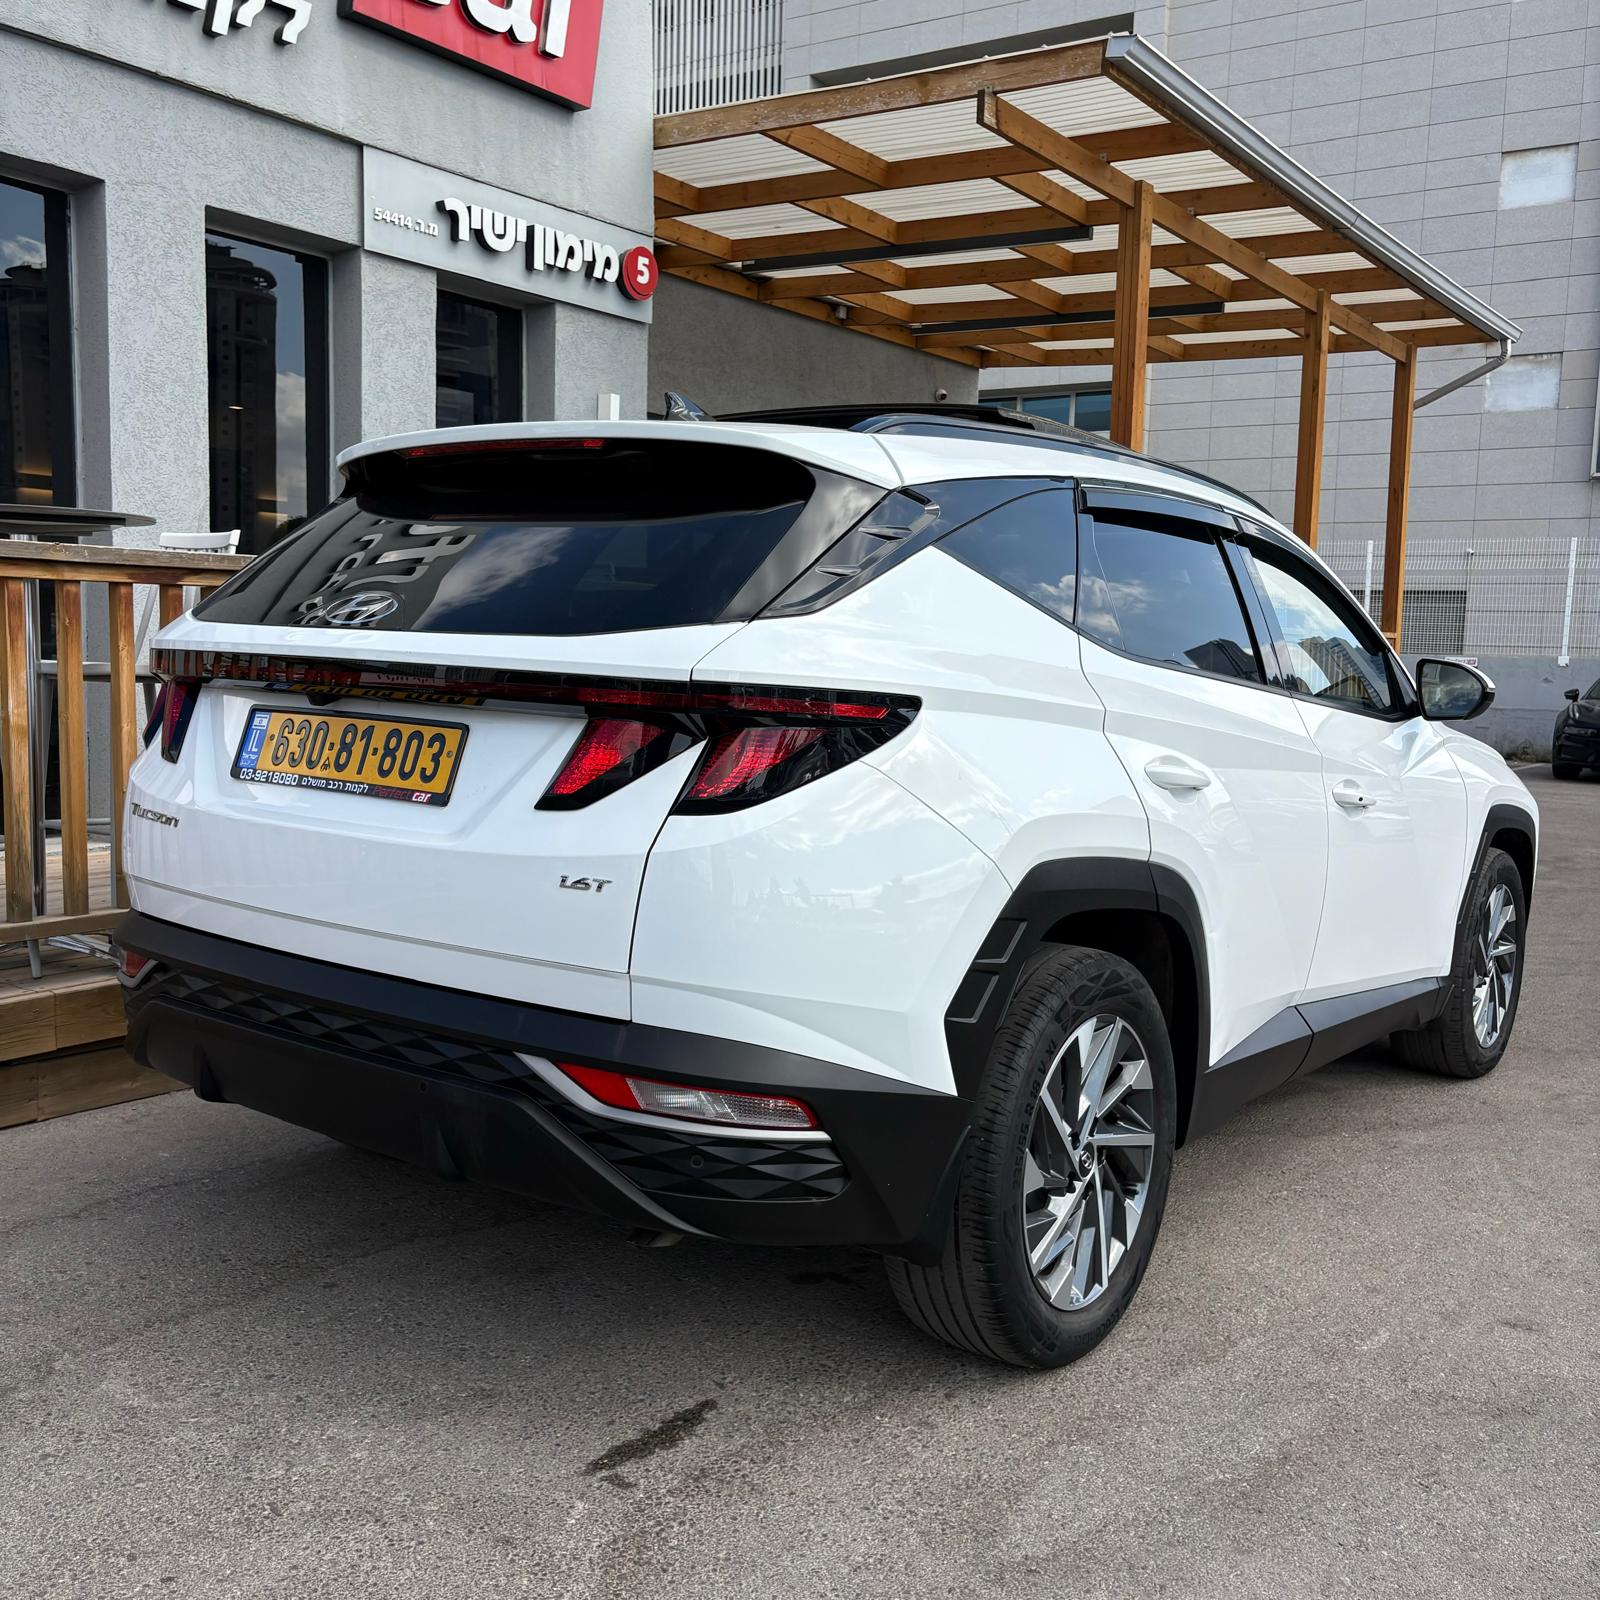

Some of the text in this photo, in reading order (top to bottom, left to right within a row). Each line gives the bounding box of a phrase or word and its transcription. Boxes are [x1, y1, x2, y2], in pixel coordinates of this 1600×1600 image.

[373, 207, 413, 229] 54414
[438, 197, 650, 284] 5 מימון ישיר
[247, 730, 260, 752] IL
[301, 776, 326, 788] מושלם
[327, 780, 343, 791] רכב
[345, 782, 369, 795] לקנות
